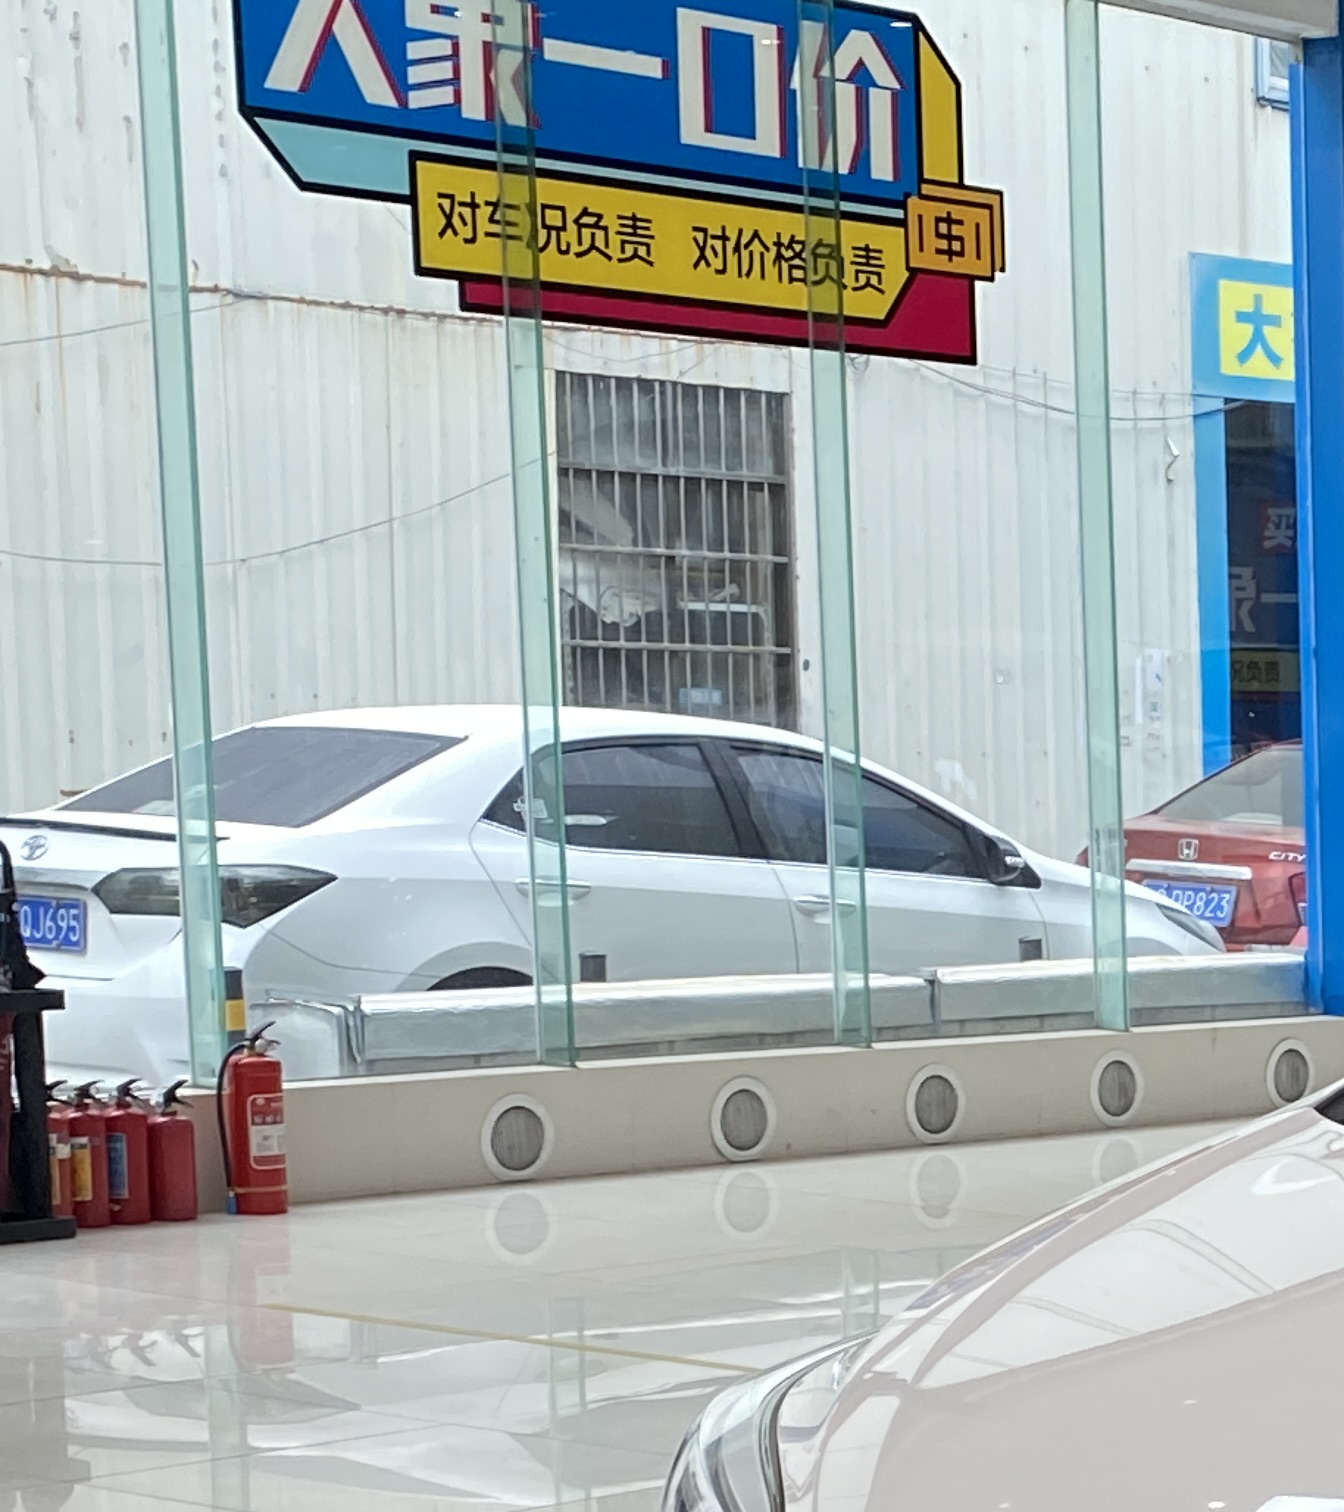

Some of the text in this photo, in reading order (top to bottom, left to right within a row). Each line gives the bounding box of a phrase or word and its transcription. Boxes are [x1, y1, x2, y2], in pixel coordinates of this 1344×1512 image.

[436, 191, 887, 295] 对车况负责 对价格负责
[1268, 851, 1307, 863] CITY
